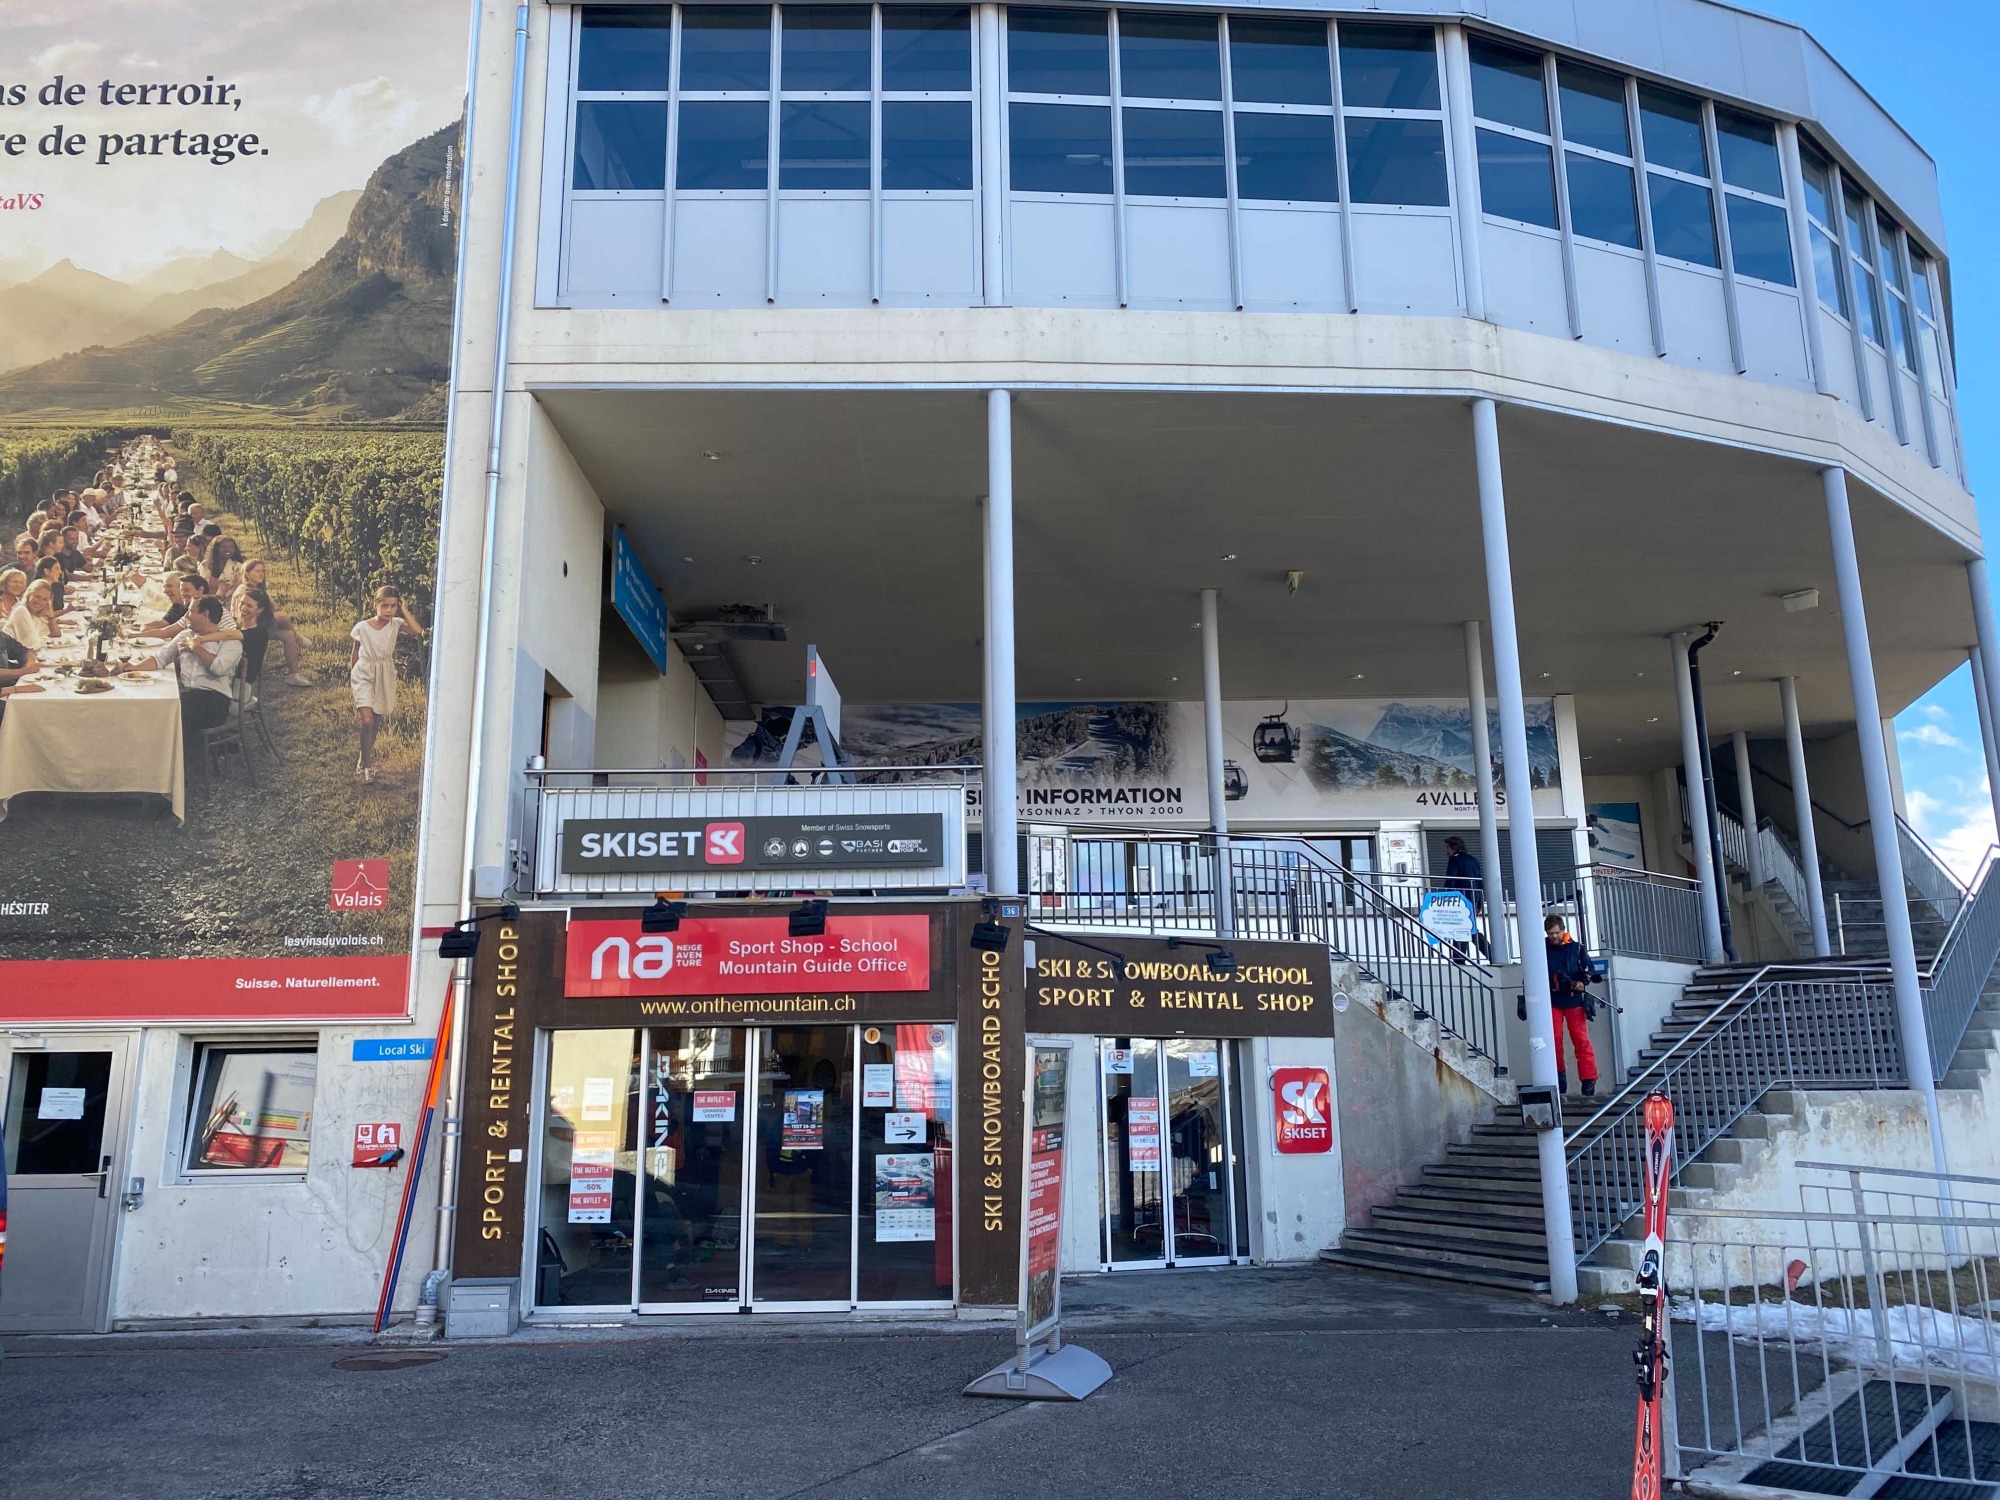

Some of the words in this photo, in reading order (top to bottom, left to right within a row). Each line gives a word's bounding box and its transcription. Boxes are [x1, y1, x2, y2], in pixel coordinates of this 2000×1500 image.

[39, 75, 86, 105] de
[98, 75, 242, 111] terroir,
[39, 125, 86, 156] de
[96, 131, 270, 165] partage.
[1026, 788, 1182, 804] INFORMATION
[1150, 807, 1183, 815] 2000
[580, 832, 701, 858] SKISET
[1, 900, 49, 915] HÉSITER
[334, 892, 382, 907] Valais
[1430, 895, 1461, 908] PUFFF!
[1006, 907, 1015, 916] 36
[284, 935, 383, 947] lesvinsduvalais.ch
[676, 944, 702, 952] NEIGE
[728, 942, 775, 956] Sport
[781, 942, 824, 956] Shop
[840, 938, 898, 953] School
[496, 926, 519, 997] SHOP
[591, 936, 673, 980] na
[676, 952, 702, 960] AVEN
[676, 959, 702, 967] TURE
[718, 959, 797, 976] Mountain
[802, 958, 852, 974] Guide
[857, 957, 907, 973] Office
[1038, 958, 1072, 978] SKI
[1076, 960, 1092, 978] &
[1096, 960, 1230, 983] SOWBOAR
[1235, 965, 1313, 985] SCHOOL
[235, 978, 281, 989] Suisse.
[286, 976, 380, 988] Naturellement.
[981, 949, 1000, 1010] SCHO
[640, 996, 856, 1015] www.onthemountain.ch
[1038, 987, 1115, 1007] SPORT
[1129, 989, 1146, 1008] &
[1160, 990, 1244, 1010] RENTAL
[1257, 993, 1314, 1012] SHOP
[379, 1043, 406, 1055] Local
[409, 1042, 426, 1055] Ski
[489, 1006, 515, 1110] RENTAL
[982, 1014, 1002, 1166] SNOWBOARD
[488, 1119, 508, 1139] &
[1284, 1127, 1327, 1139] SKISET
[984, 1174, 1003, 1190] &
[482, 1148, 507, 1240] SPORT
[984, 1194, 1003, 1232] SKI
